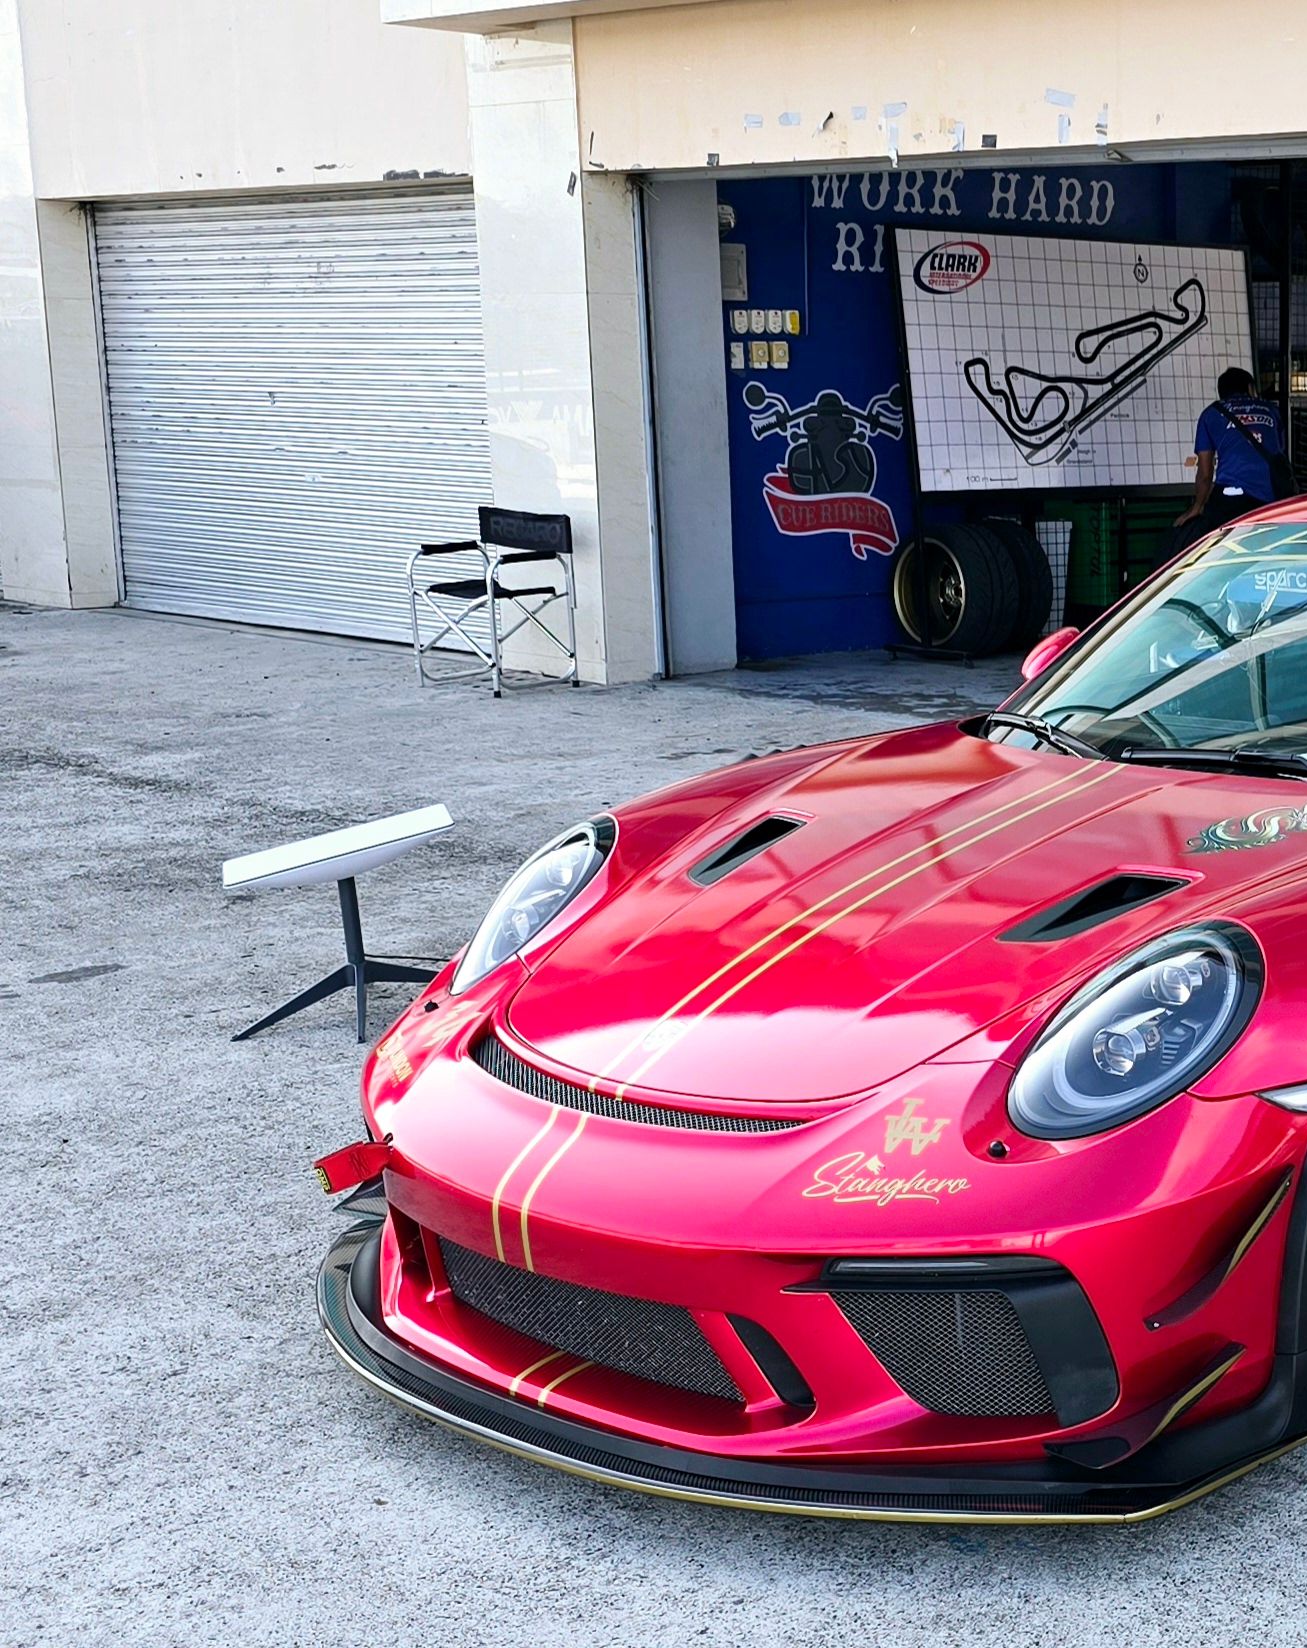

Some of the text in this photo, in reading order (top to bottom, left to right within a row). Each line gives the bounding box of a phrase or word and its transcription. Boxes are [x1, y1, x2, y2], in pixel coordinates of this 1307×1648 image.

[811, 168, 1115, 226] WORK HARD
[831, 221, 885, 274] RI
[929, 252, 980, 273] CLARK
[489, 515, 561, 545] RECARO
[777, 500, 890, 531] CUE RIDERS
[802, 1151, 972, 1207] Stanghero
